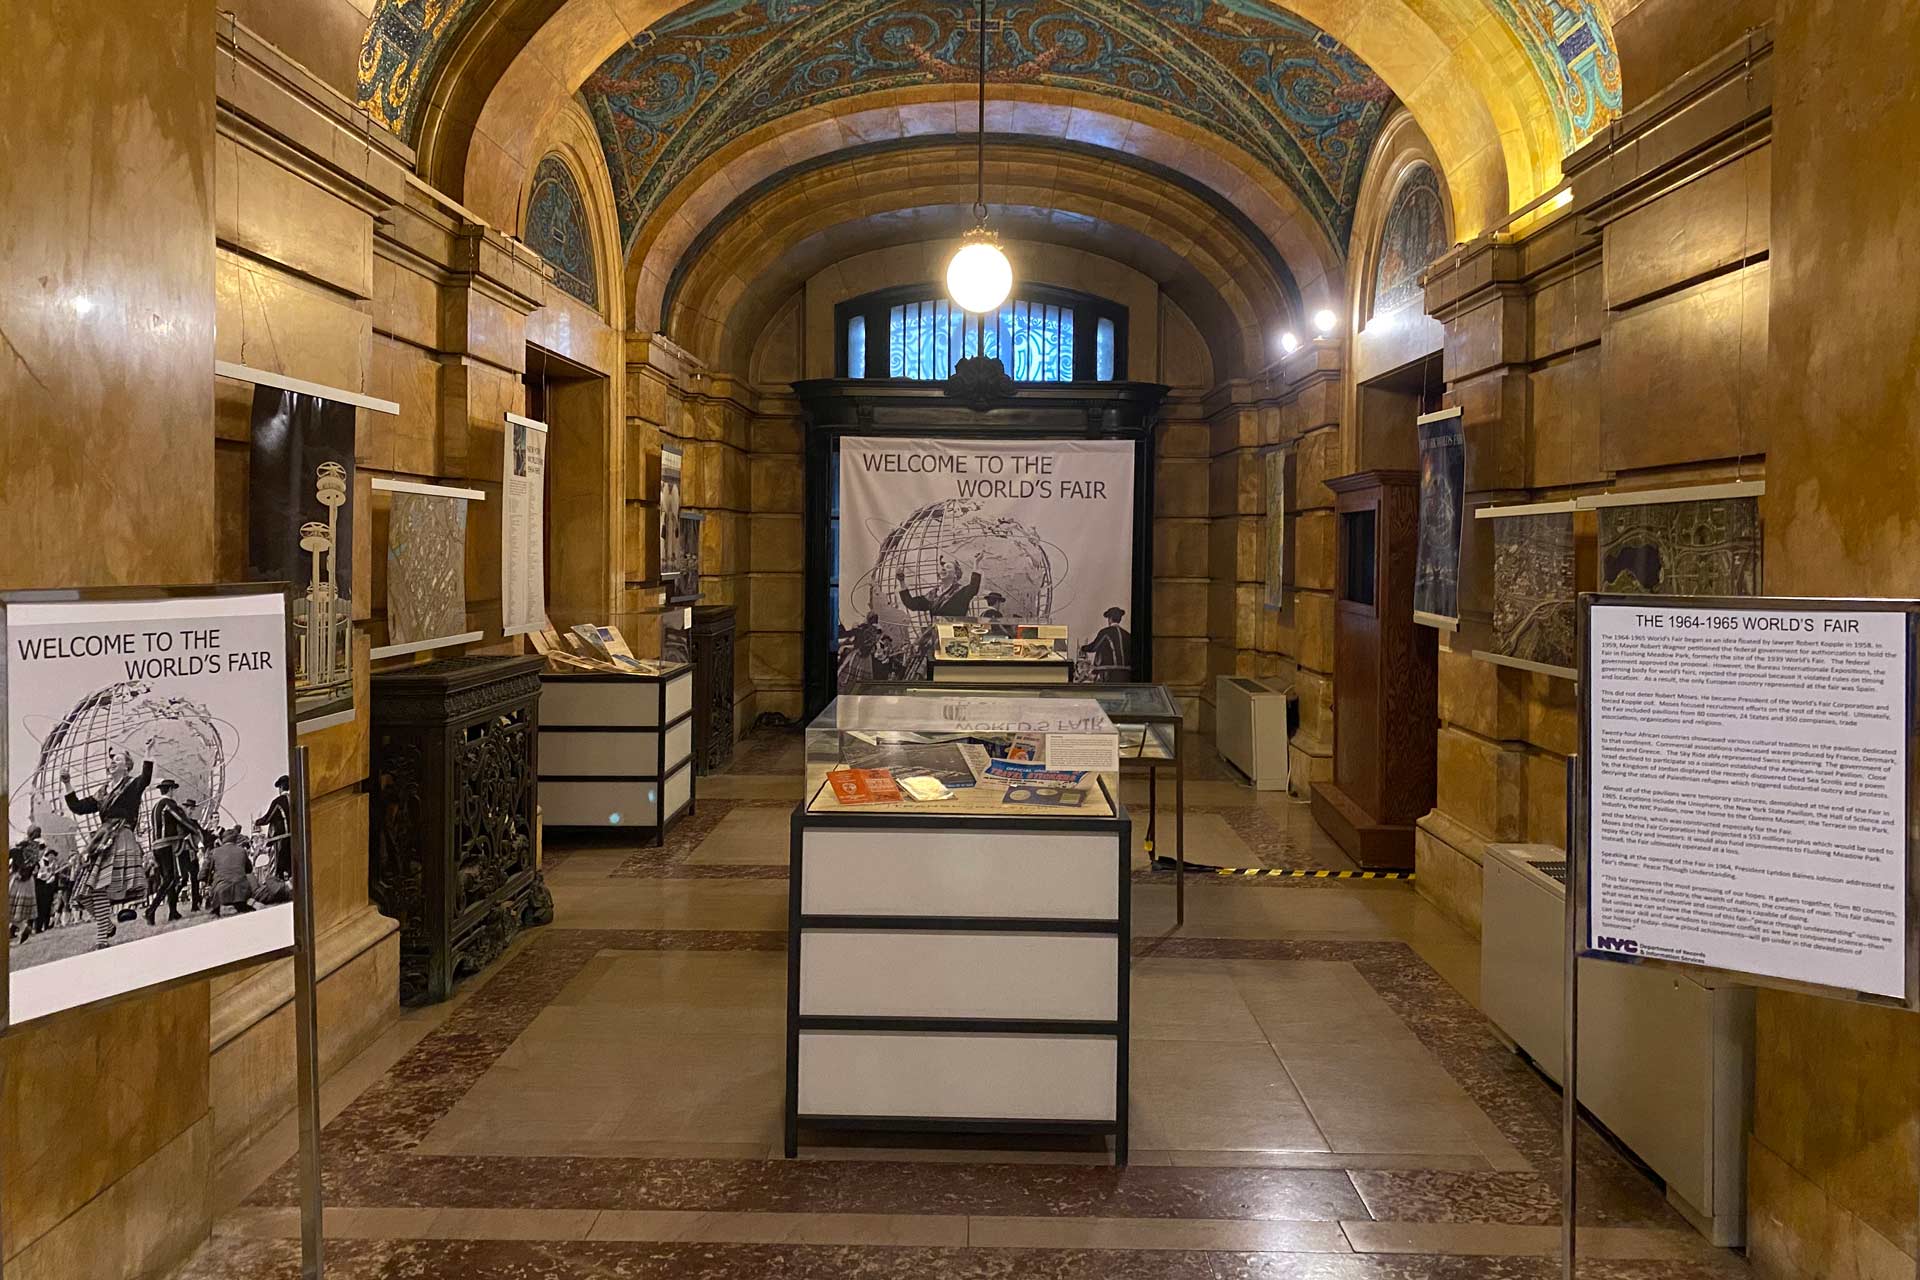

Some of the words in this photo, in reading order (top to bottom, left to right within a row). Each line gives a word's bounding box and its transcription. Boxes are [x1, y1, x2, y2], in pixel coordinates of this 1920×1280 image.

[863, 454, 967, 473] WELCOME
[975, 455, 1003, 473] TO
[1011, 456, 1052, 474] THE
[957, 479, 1052, 499] WORLD'S
[1060, 480, 1107, 499] FAIR
[1636, 614, 1664, 628] THE
[1668, 615, 1738, 630] 1964-1965
[1743, 617, 1814, 632] WORLD'S
[1824, 619, 1859, 633] FAIR
[18, 633, 135, 660] WELCOME
[142, 632, 173, 652] TO
[180, 629, 220, 650] THE
[125, 654, 221, 680] WORLD'S
[229, 651, 272, 671] FAIR
[1598, 935, 1638, 953] NYC
